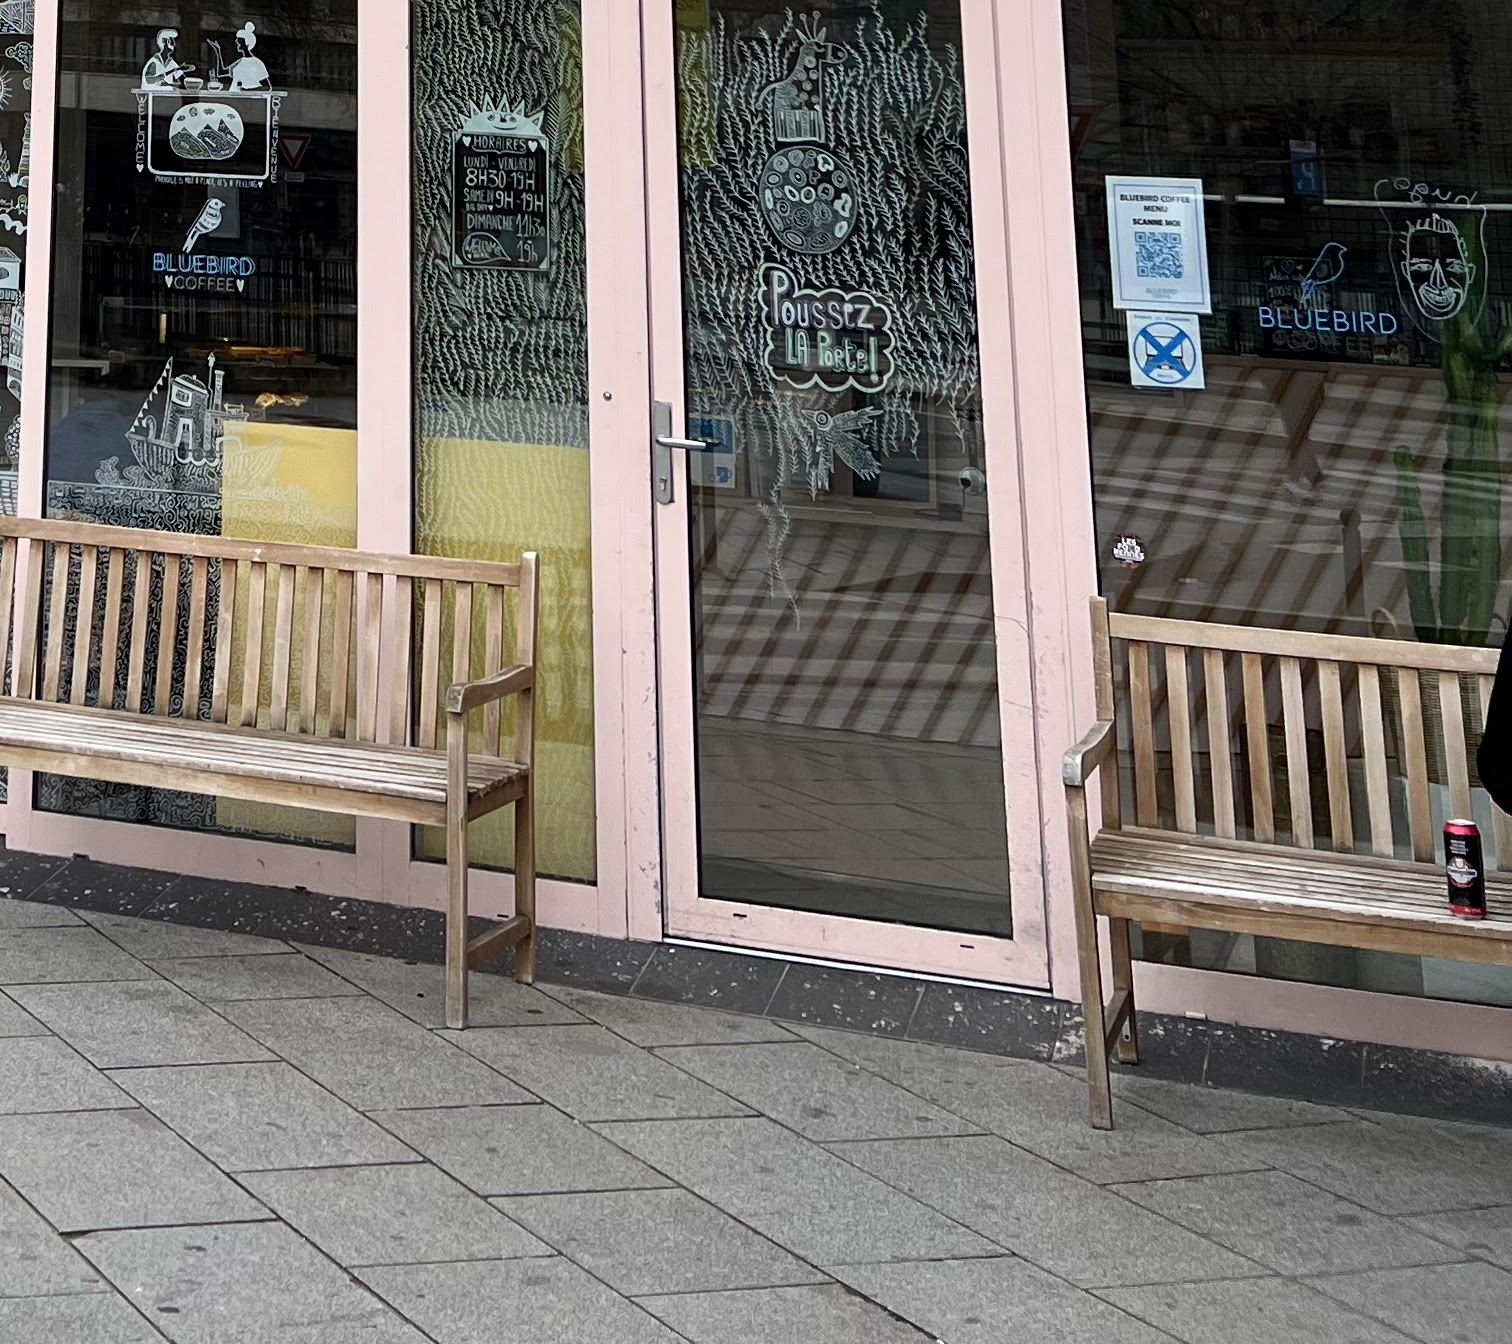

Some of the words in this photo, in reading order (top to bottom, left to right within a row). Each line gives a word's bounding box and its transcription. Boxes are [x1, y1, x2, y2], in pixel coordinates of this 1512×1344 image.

[135, 93, 148, 163] WELCOME
[271, 96, 282, 184] BIENVENUE
[473, 135, 527, 150] HORAIRES
[463, 154, 489, 168] LUNDI
[463, 188, 494, 203] SAMEDI
[1119, 193, 1159, 202] BLUEBIRD
[1160, 195, 1191, 204] COFFEE
[1143, 205, 1169, 213] MENU
[467, 213, 514, 231] DIMANCHE
[1132, 218, 1164, 227] SCANNE
[152, 252, 256, 276] BLUEBIRD
[174, 275, 236, 292] COFFEE
[1258, 306, 1398, 335] BLUEBIRD
[784, 327, 810, 366] LA
